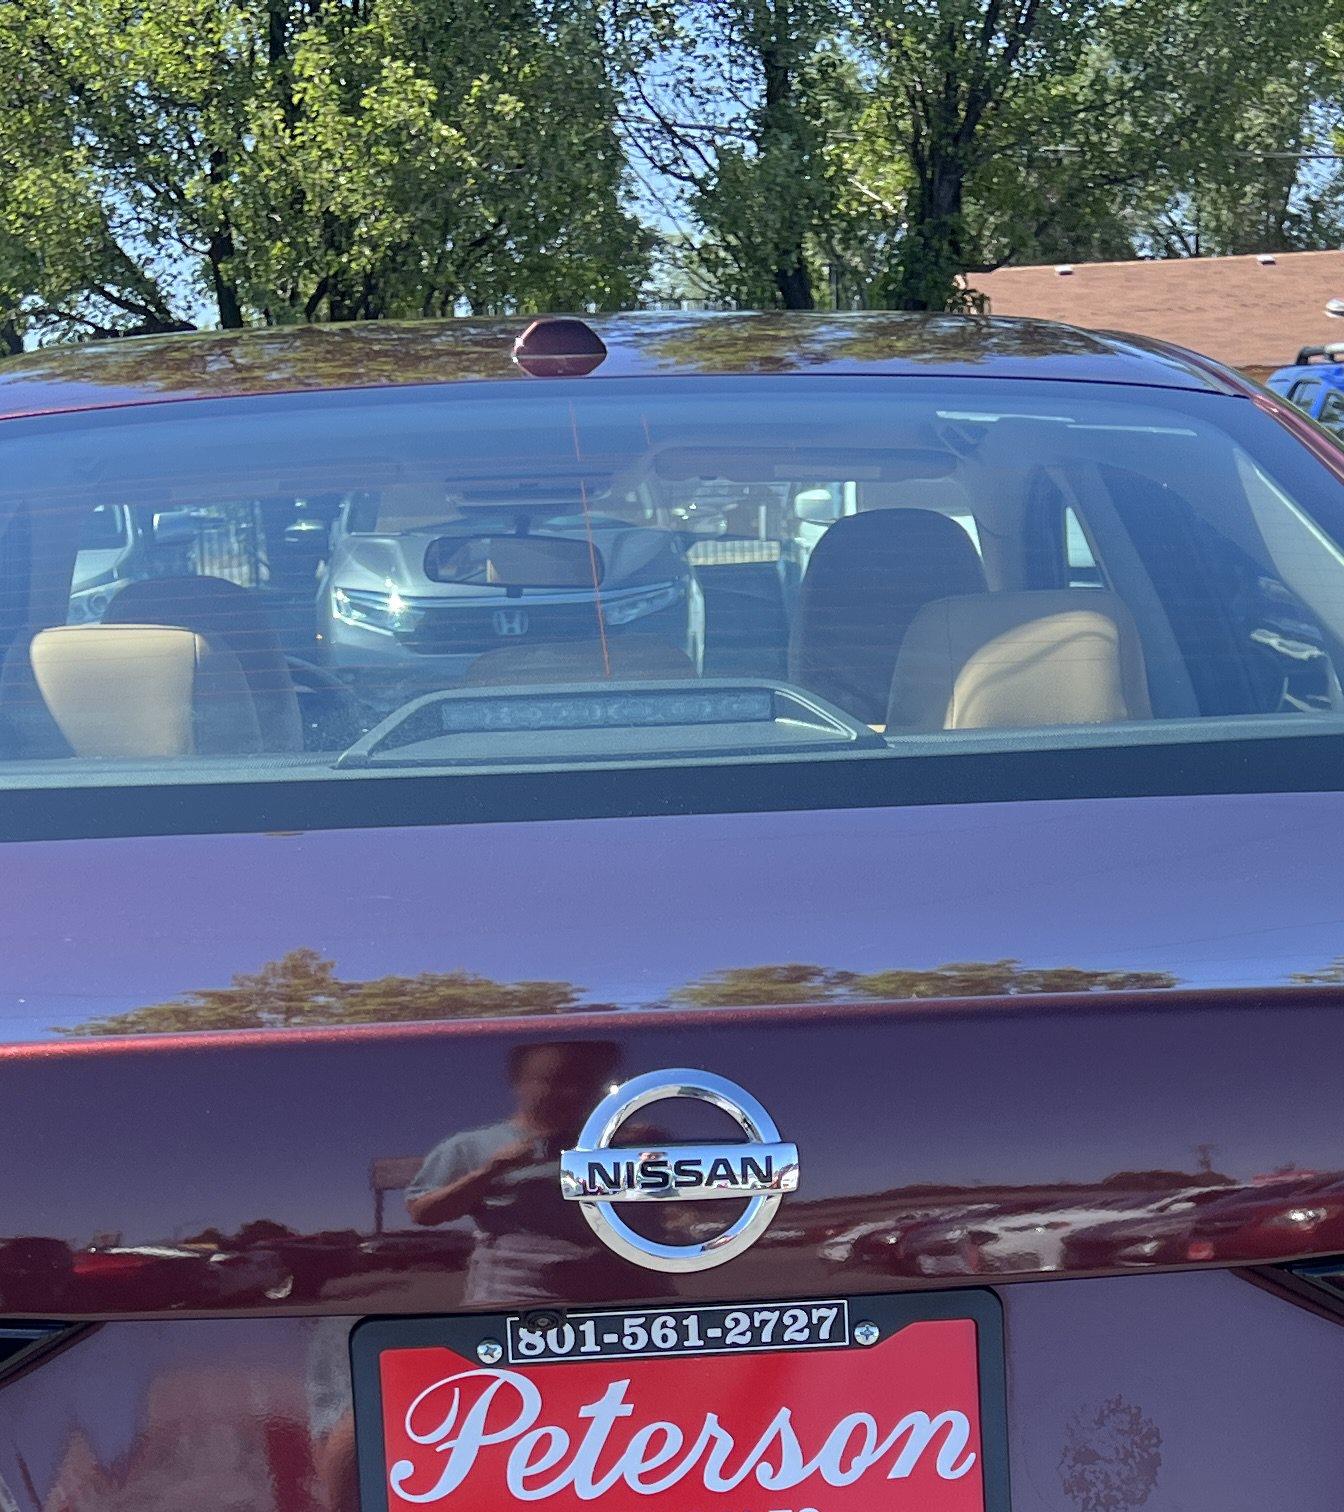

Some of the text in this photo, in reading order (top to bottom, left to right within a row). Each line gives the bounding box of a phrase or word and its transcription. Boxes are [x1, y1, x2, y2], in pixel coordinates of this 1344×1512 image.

[587, 1155, 773, 1190] NISSAN
[518, 1307, 838, 1356] 801-561-2727
[389, 1368, 977, 1504] Peterson
